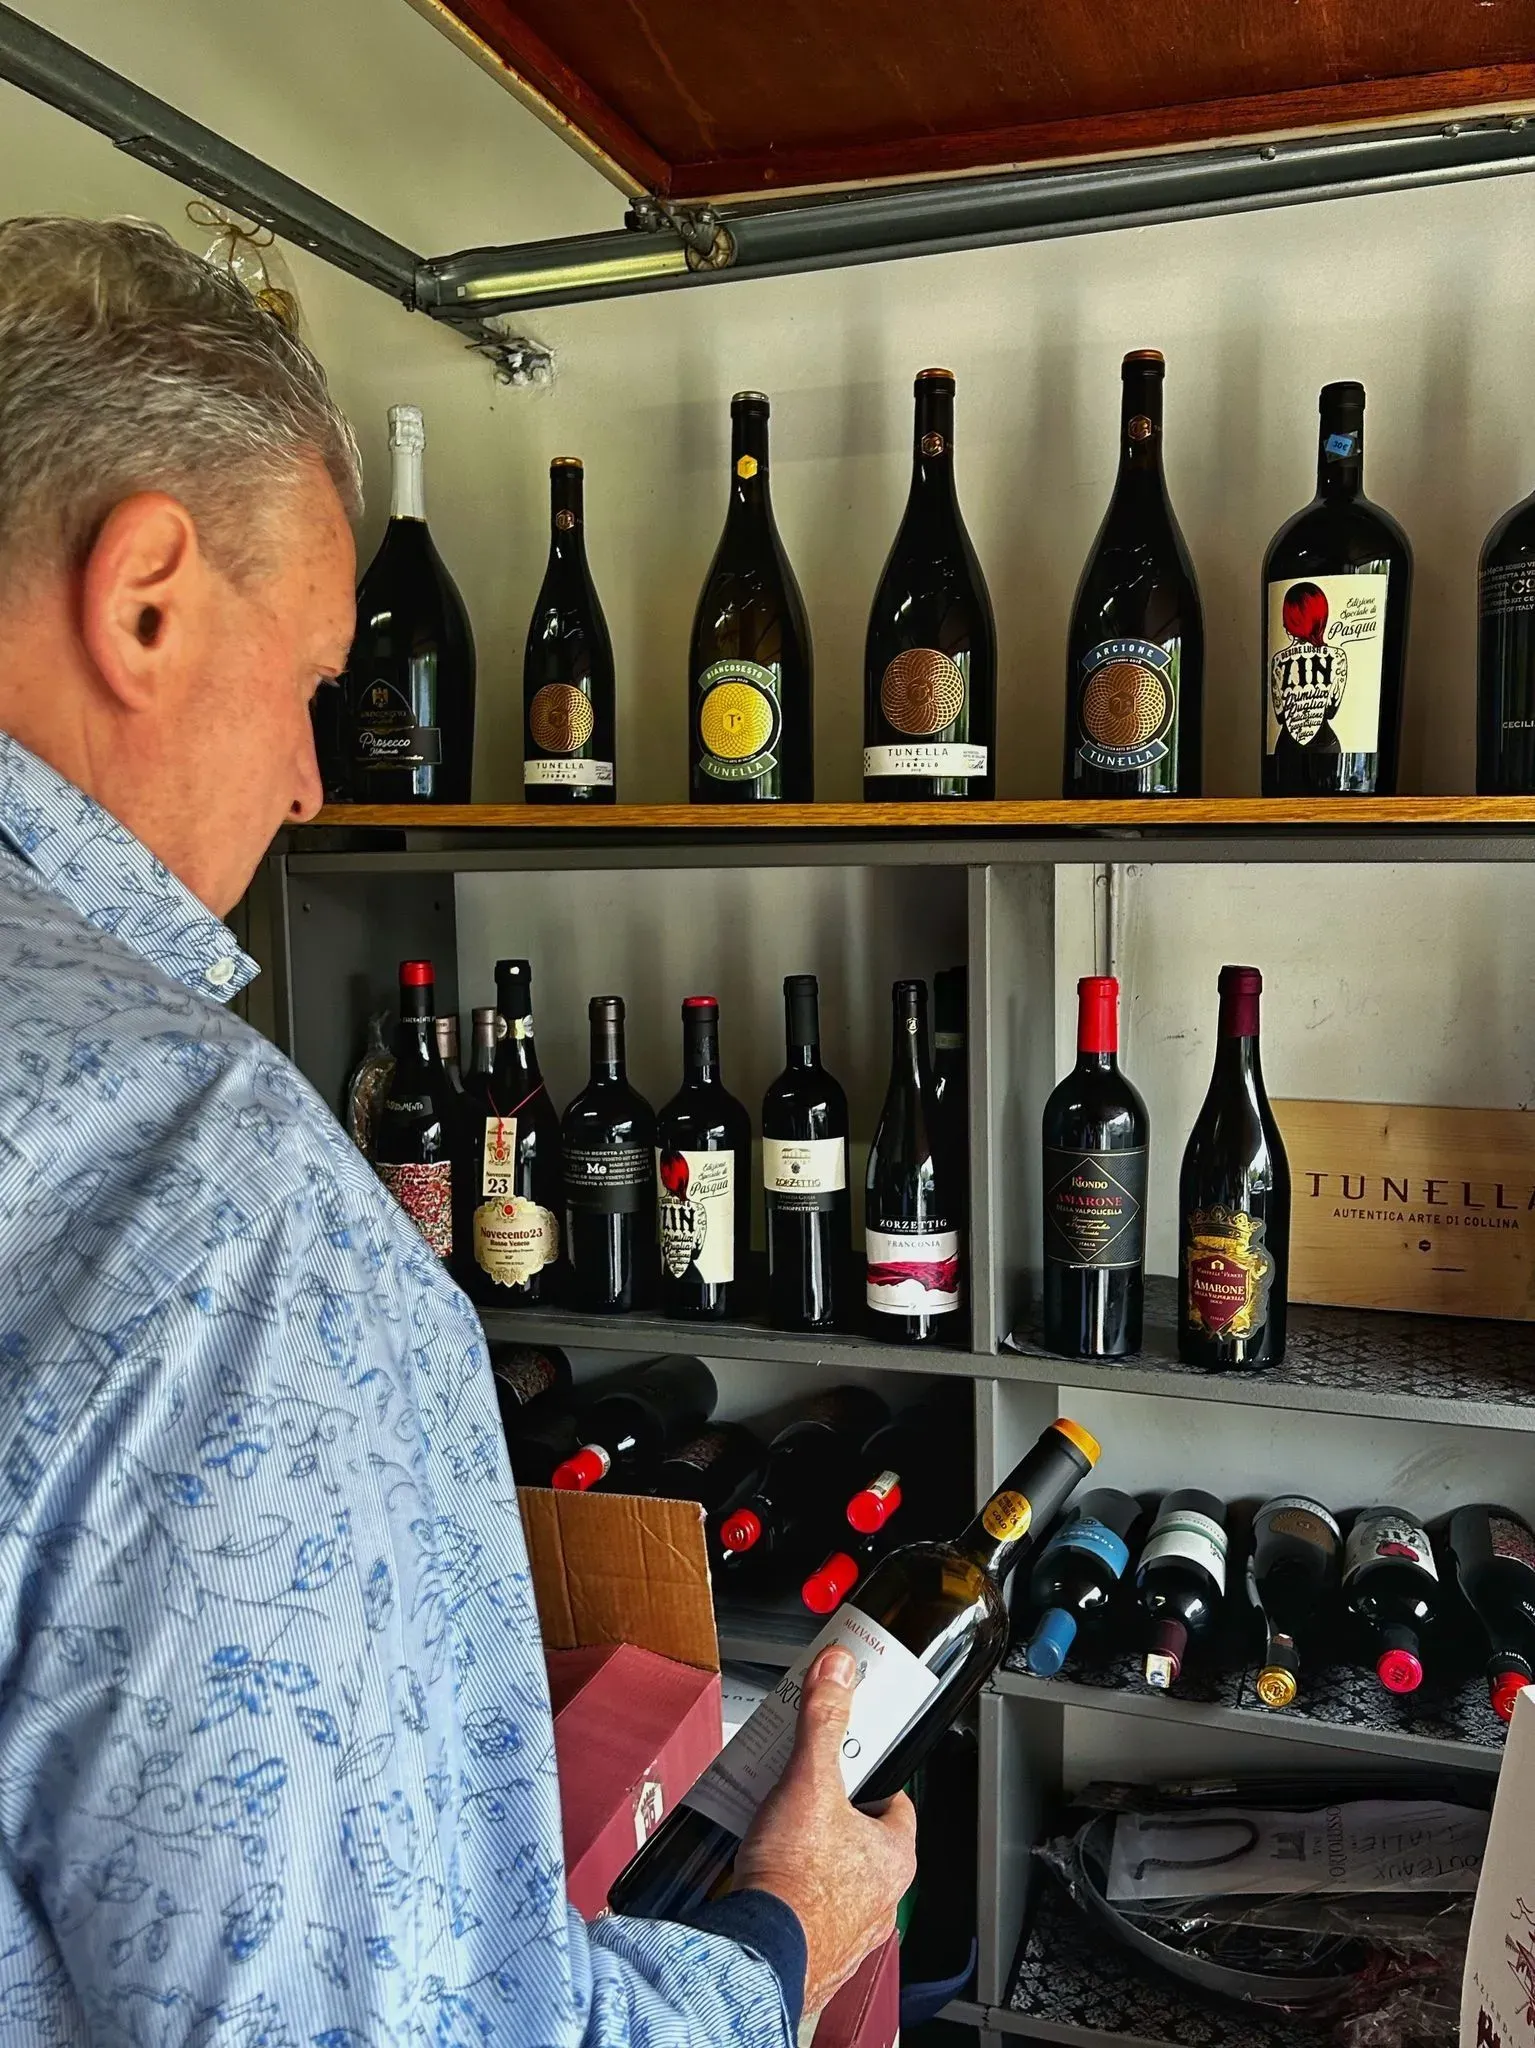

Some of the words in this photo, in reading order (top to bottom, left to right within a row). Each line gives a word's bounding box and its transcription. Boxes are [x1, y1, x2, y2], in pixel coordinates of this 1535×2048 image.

[1346, 597, 1377, 609] Edizione
[1369, 605, 1377, 615] di
[1515, 603, 1535, 611] ITALY
[1327, 620, 1377, 640] Pasqua
[1095, 643, 1155, 660] ARCIONE
[1280, 646, 1303, 660] DESIRE
[706, 664, 764, 680] BIANCOSESTO
[1277, 654, 1336, 692] ZIN
[1502, 719, 1535, 729] CECILI
[359, 731, 412, 749] Prosecco
[887, 747, 950, 757] TUNELLA
[1089, 750, 1155, 766] TUNELLA
[536, 762, 585, 770] TUNELLA
[707, 762, 764, 777] TUNELLA
[586, 1162, 607, 1175] Me
[487, 1177, 509, 1194] 23
[689, 1179, 729, 1197] Pasqua
[1057, 1193, 1123, 1207] AMARONE
[660, 1204, 696, 1233] ZIN
[1074, 1207, 1123, 1216] VALPOLICELLA
[1333, 1207, 1405, 1223] AUTENTICA
[1408, 1212, 1441, 1225] ARTE
[1446, 1215, 1460, 1226] DI
[1463, 1216, 1520, 1230] COLLINA
[879, 1218, 947, 1230] ZORZETTIG
[887, 1239, 941, 1248] FRANCONIA
[1193, 1279, 1245, 1295] AMARONE
[992, 1510, 1007, 1529] GOLD
[843, 1617, 887, 1656] MALVASIA
[1325, 1806, 1348, 1877] ORTOLUSSO
[1373, 1855, 1478, 1881] OUTEAUX
